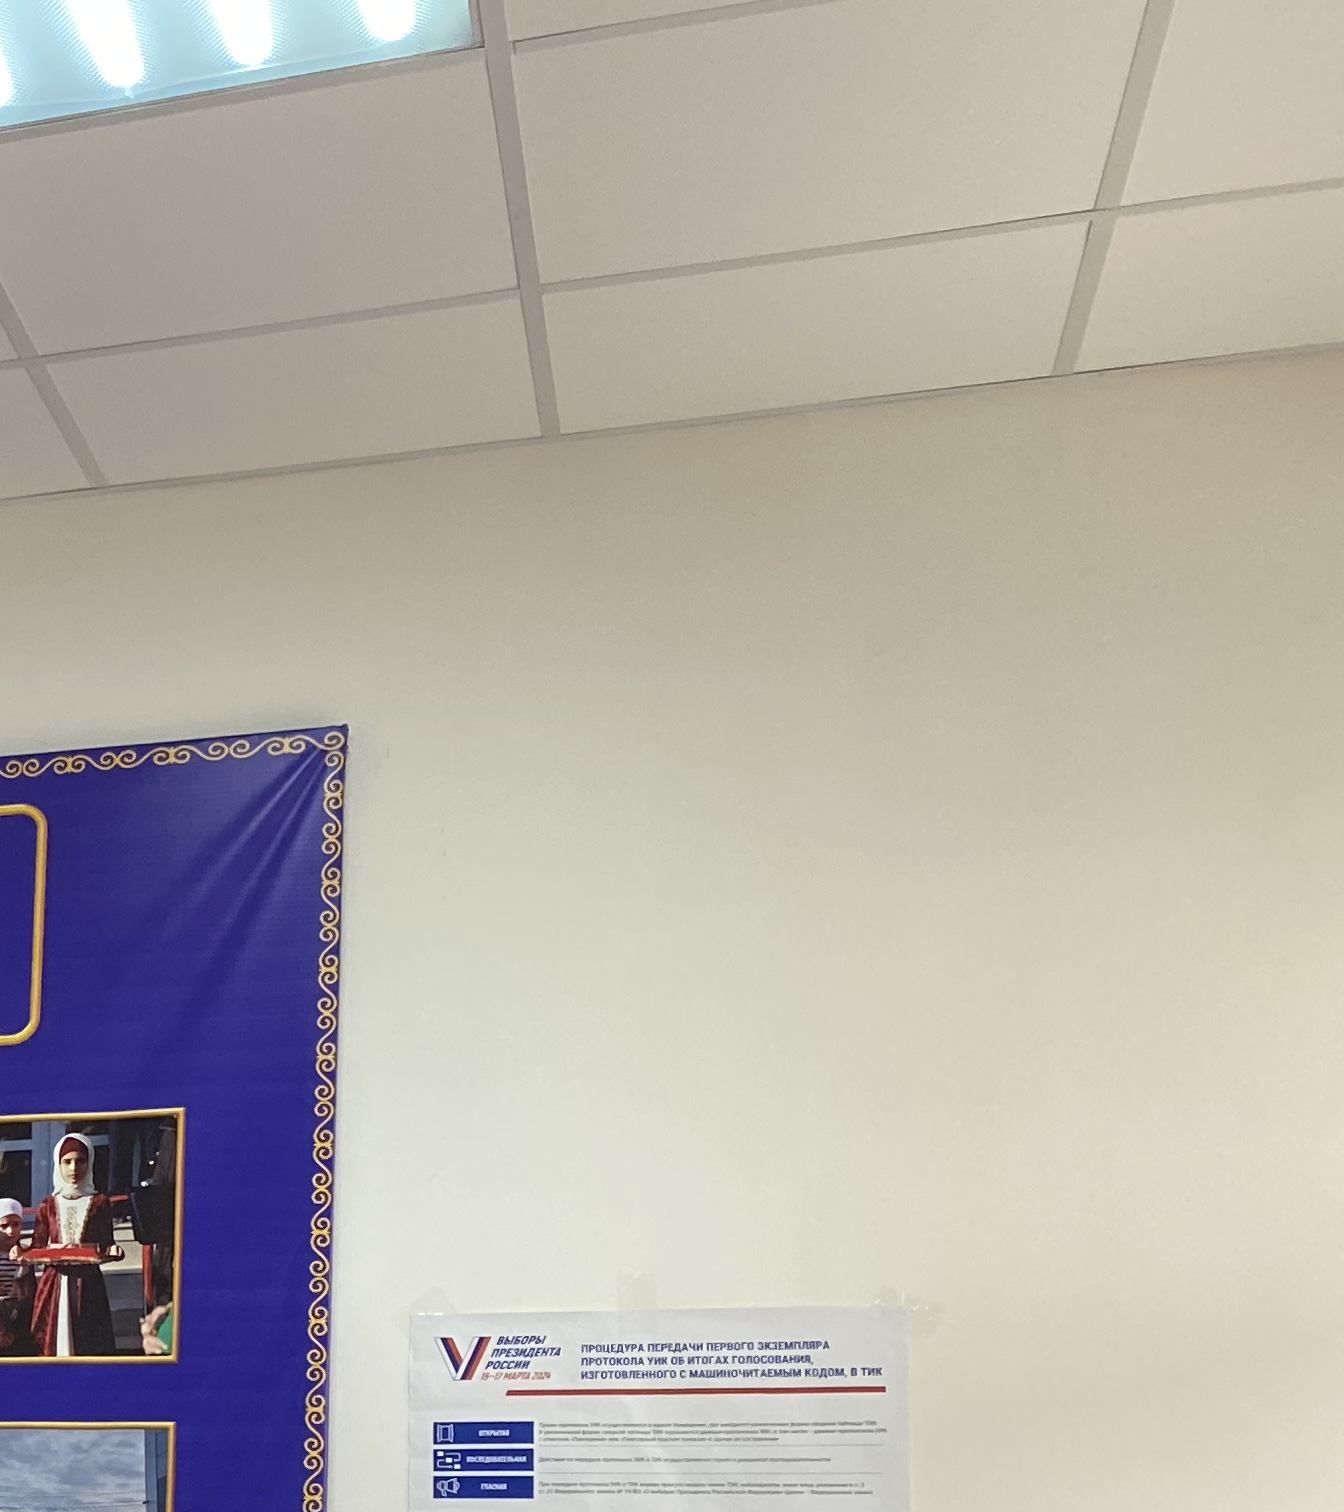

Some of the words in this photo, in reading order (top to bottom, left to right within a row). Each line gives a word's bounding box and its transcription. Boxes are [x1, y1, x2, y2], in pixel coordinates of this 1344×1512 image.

[496, 1336, 547, 1346] ВЫБОРЫ
[491, 1347, 562, 1358] ПРЕЗИДЕНТА
[581, 1343, 646, 1355] ПРОЦЕДУРА
[647, 1342, 704, 1354] ПЕРЕДАЧИ
[706, 1341, 755, 1352] ПЕРВОГО
[757, 1340, 830, 1351] ЭКЗЕМПЛЯРА
[485, 1360, 532, 1370] РОССИИ
[581, 1356, 645, 1367] ПРОТОКОЛА
[648, 1356, 668, 1367] УИК
[670, 1356, 685, 1366] ОБ
[687, 1355, 729, 1366] ИТОГАХ
[581, 1369, 677, 1380] ИЗГОТОВЛЕННОГО
[679, 1369, 687, 1379] С
[689, 1368, 801, 1379] МАШИНОЧИТАЕМЫМ
[850, 1368, 858, 1378] В
[861, 1367, 883, 1377] ТИК
